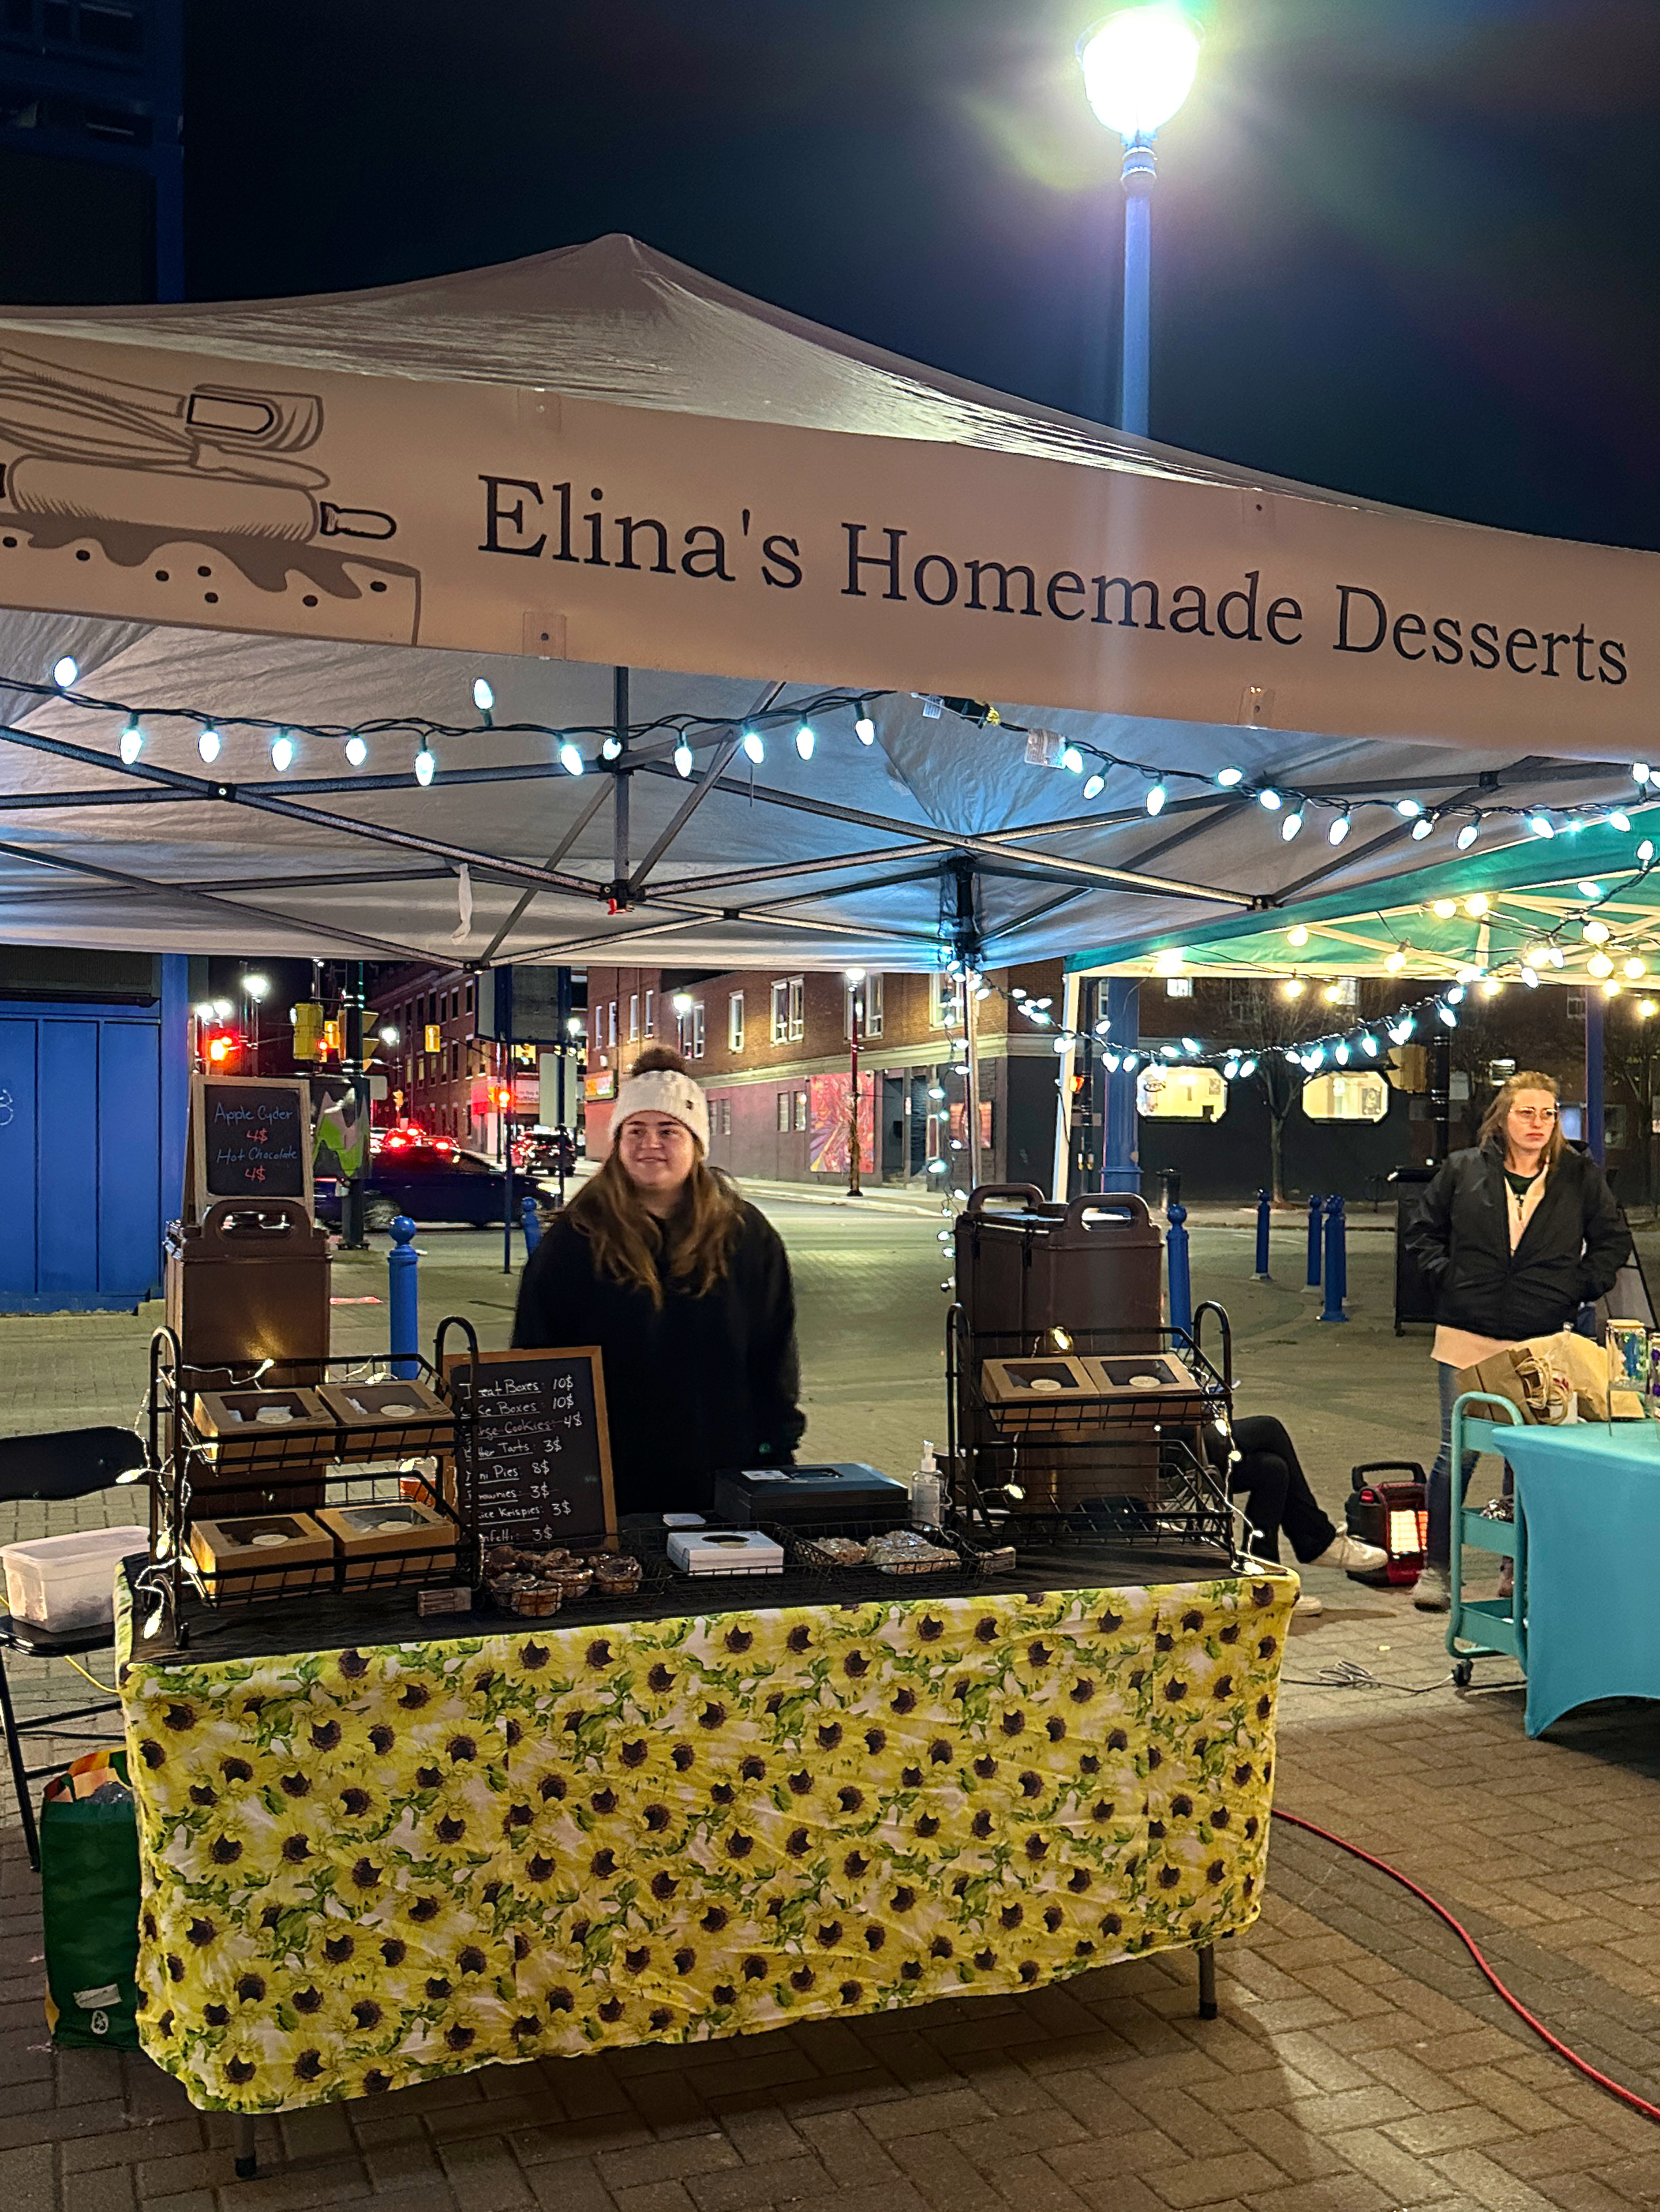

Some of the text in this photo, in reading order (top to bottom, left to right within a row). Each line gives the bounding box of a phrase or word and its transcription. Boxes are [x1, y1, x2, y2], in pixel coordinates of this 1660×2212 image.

[478, 474, 1628, 685] Elina's Homemade Desserts
[214, 1102, 293, 1125] Apple Cyder
[246, 1127, 268, 1145] 4$
[216, 1145, 297, 1165] Hot Chocolate
[244, 1165, 266, 1183] 4$
[552, 1374, 574, 1391] 10$
[552, 1393, 574, 1410] 10$
[564, 1411, 582, 1428] 4$
[543, 1435, 562, 1453] 3$
[532, 1459, 550, 1475] 8$
[530, 1481, 550, 1499] 3$
[551, 1499, 572, 1516] 3$
[532, 1524, 553, 1542] 3$
